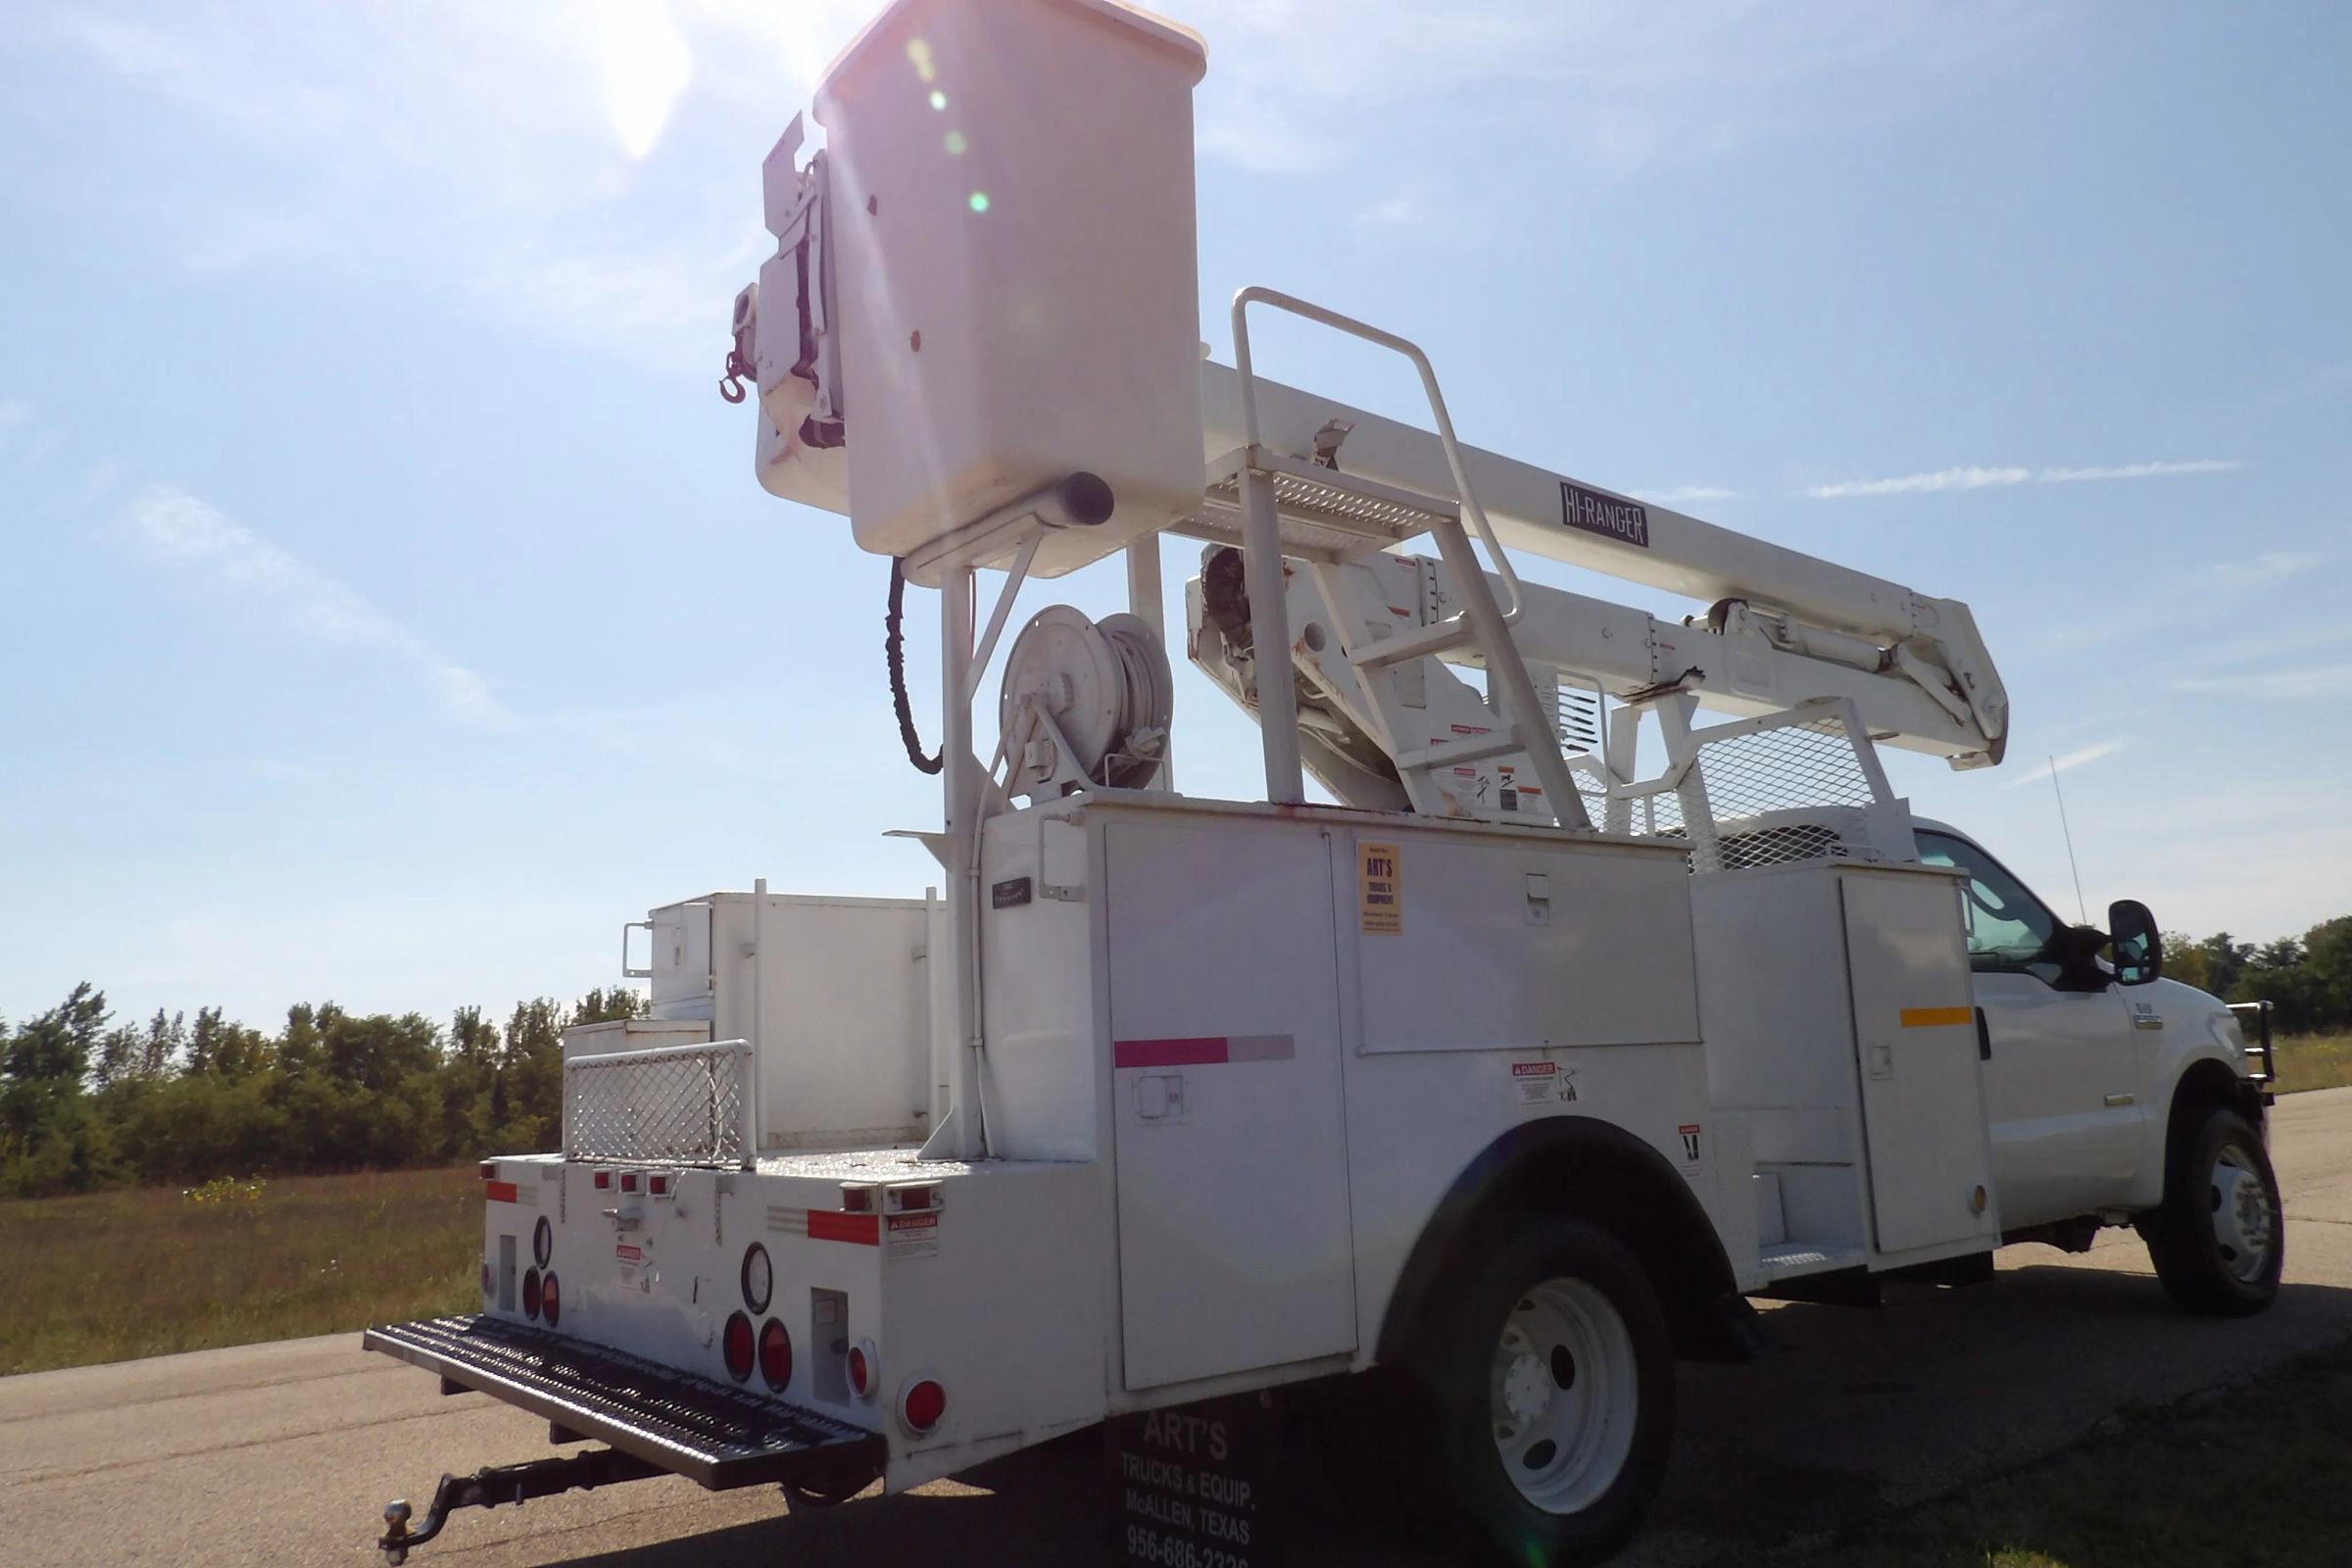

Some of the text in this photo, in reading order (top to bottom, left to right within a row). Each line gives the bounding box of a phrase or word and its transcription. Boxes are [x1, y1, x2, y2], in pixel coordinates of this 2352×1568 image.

[1563, 484, 1644, 545] HI-RANGER
[1521, 1064, 1553, 1076] DANGER
[899, 1215, 936, 1229] DANGER
[1143, 1410, 1229, 1460] ART'S
[1120, 1451, 1255, 1511] TRUCKS & EQUIP.
[1126, 1488, 1250, 1545] McALLEN, TEXAS
